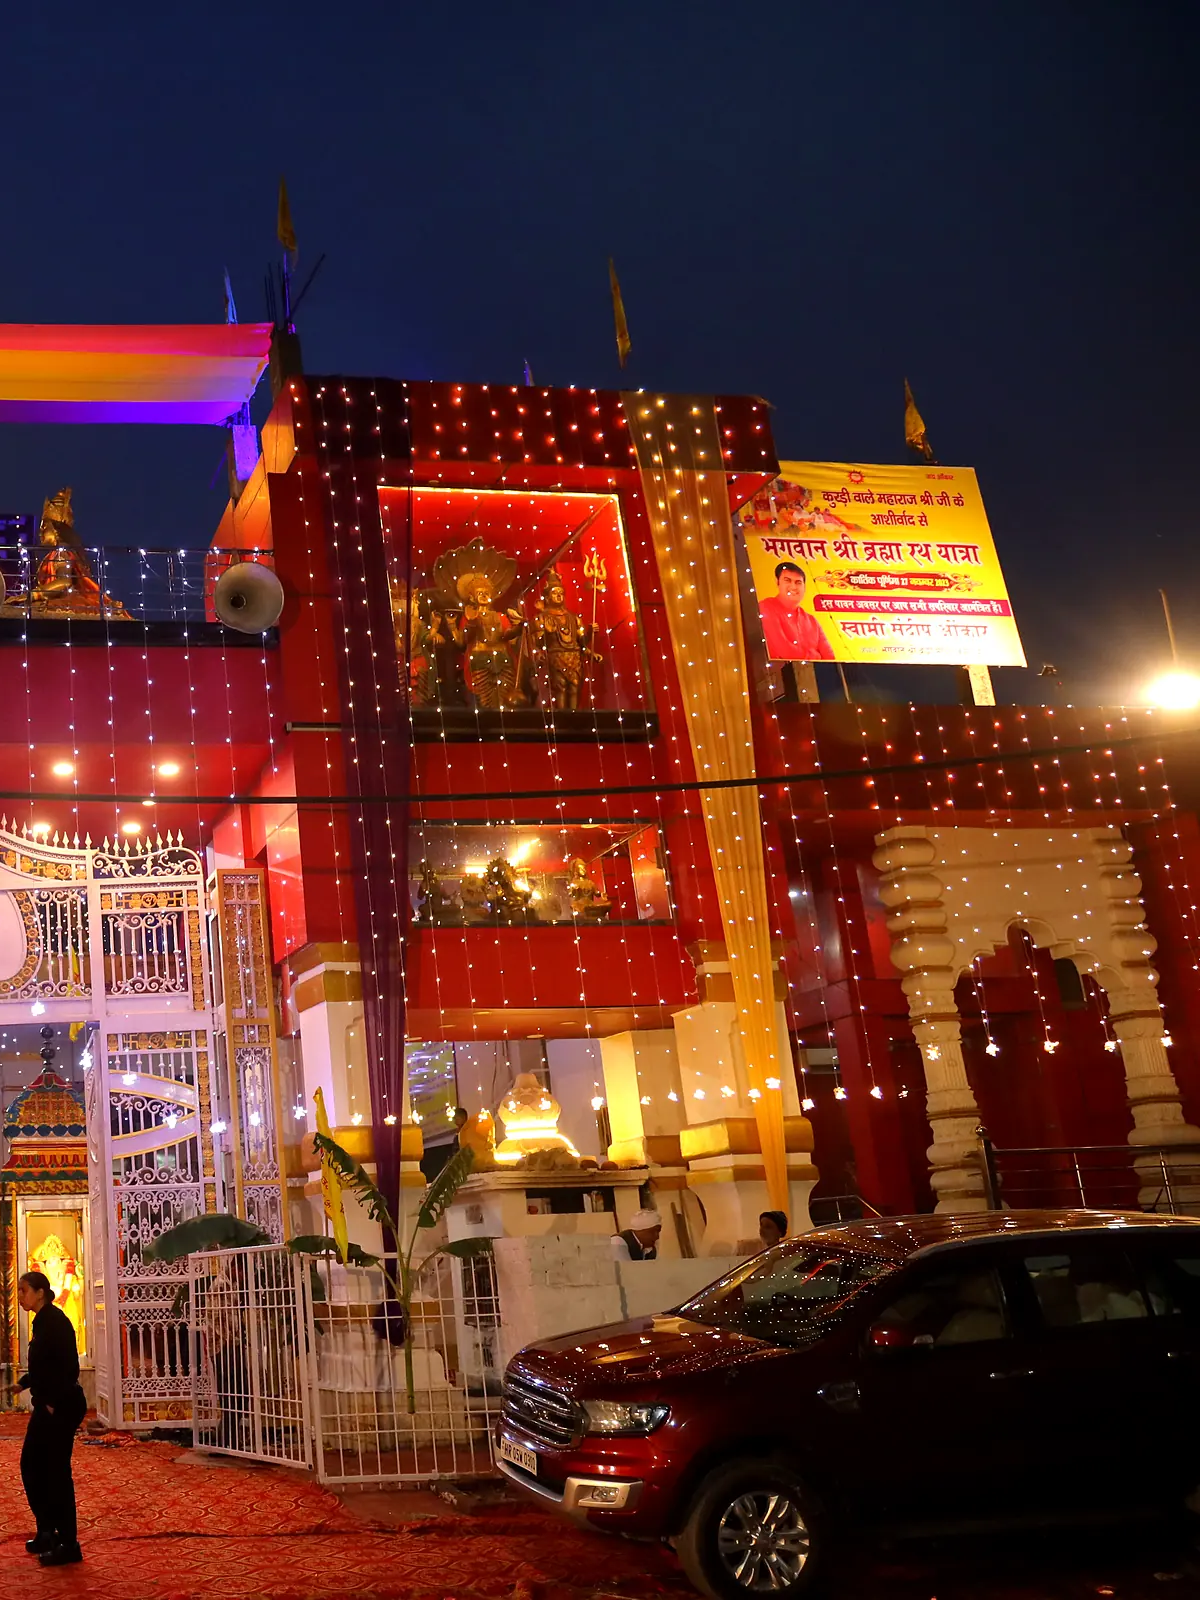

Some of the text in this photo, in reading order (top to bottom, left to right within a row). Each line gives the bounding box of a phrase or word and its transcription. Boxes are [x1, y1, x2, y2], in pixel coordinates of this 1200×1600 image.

[854, 489, 875, 504] वाले
[876, 493, 918, 505] महाराज
[920, 491, 934, 506] श्री
[935, 491, 951, 506] जी
[952, 493, 964, 507] के
[870, 510, 928, 526] आशीर्वाद से
[761, 533, 981, 566] भगवान श्री ब्रह्मा रथ यात्रा
[850, 574, 876, 584] कार्तिक
[876, 575, 900, 588] पूर्णिमा
[820, 599, 834, 610] इस
[834, 600, 854, 609] पावन
[856, 600, 881, 611] अवसर
[881, 601, 892, 611] पर
[892, 601, 908, 610] आप
[908, 599, 927, 611] सभी
[928, 600, 960, 613] सपरिवार
[960, 601, 991, 612] आमंत्रित
[840, 617, 885, 637] स्वामी
